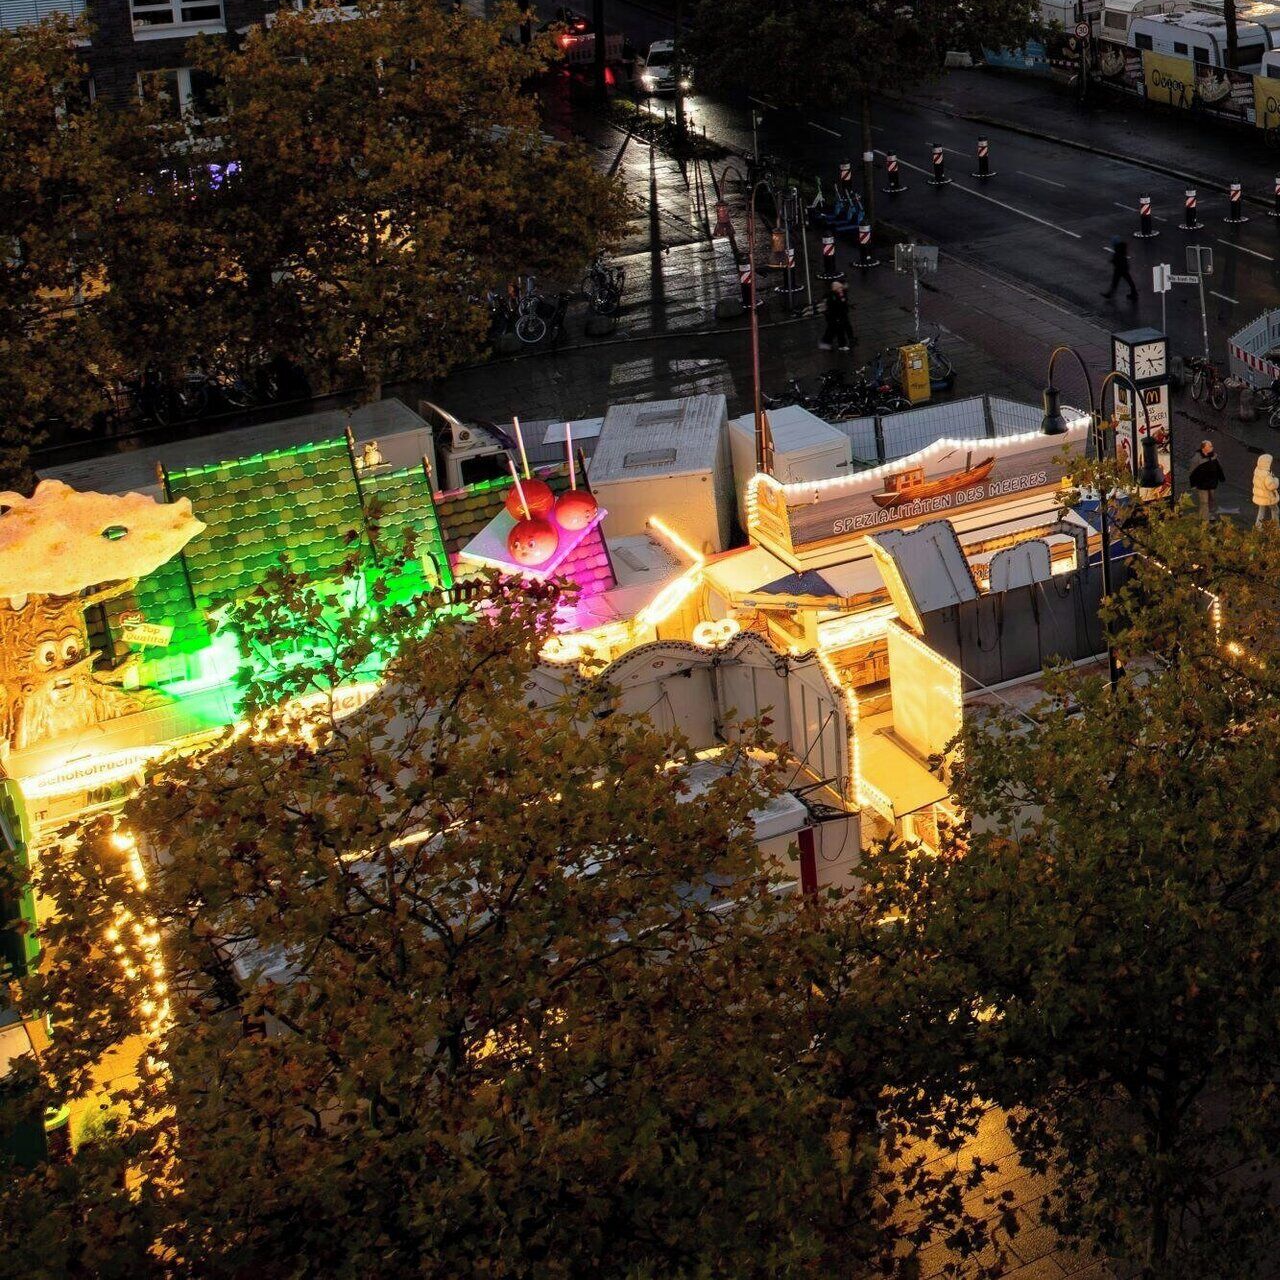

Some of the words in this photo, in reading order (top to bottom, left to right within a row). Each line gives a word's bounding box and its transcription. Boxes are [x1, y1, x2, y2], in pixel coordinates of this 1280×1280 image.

[1077, 25, 1088, 35] 30
[833, 494, 951, 534] SPEZIALITÄTEN
[955, 484, 985, 504] DES
[989, 470, 1047, 496] MEERES
